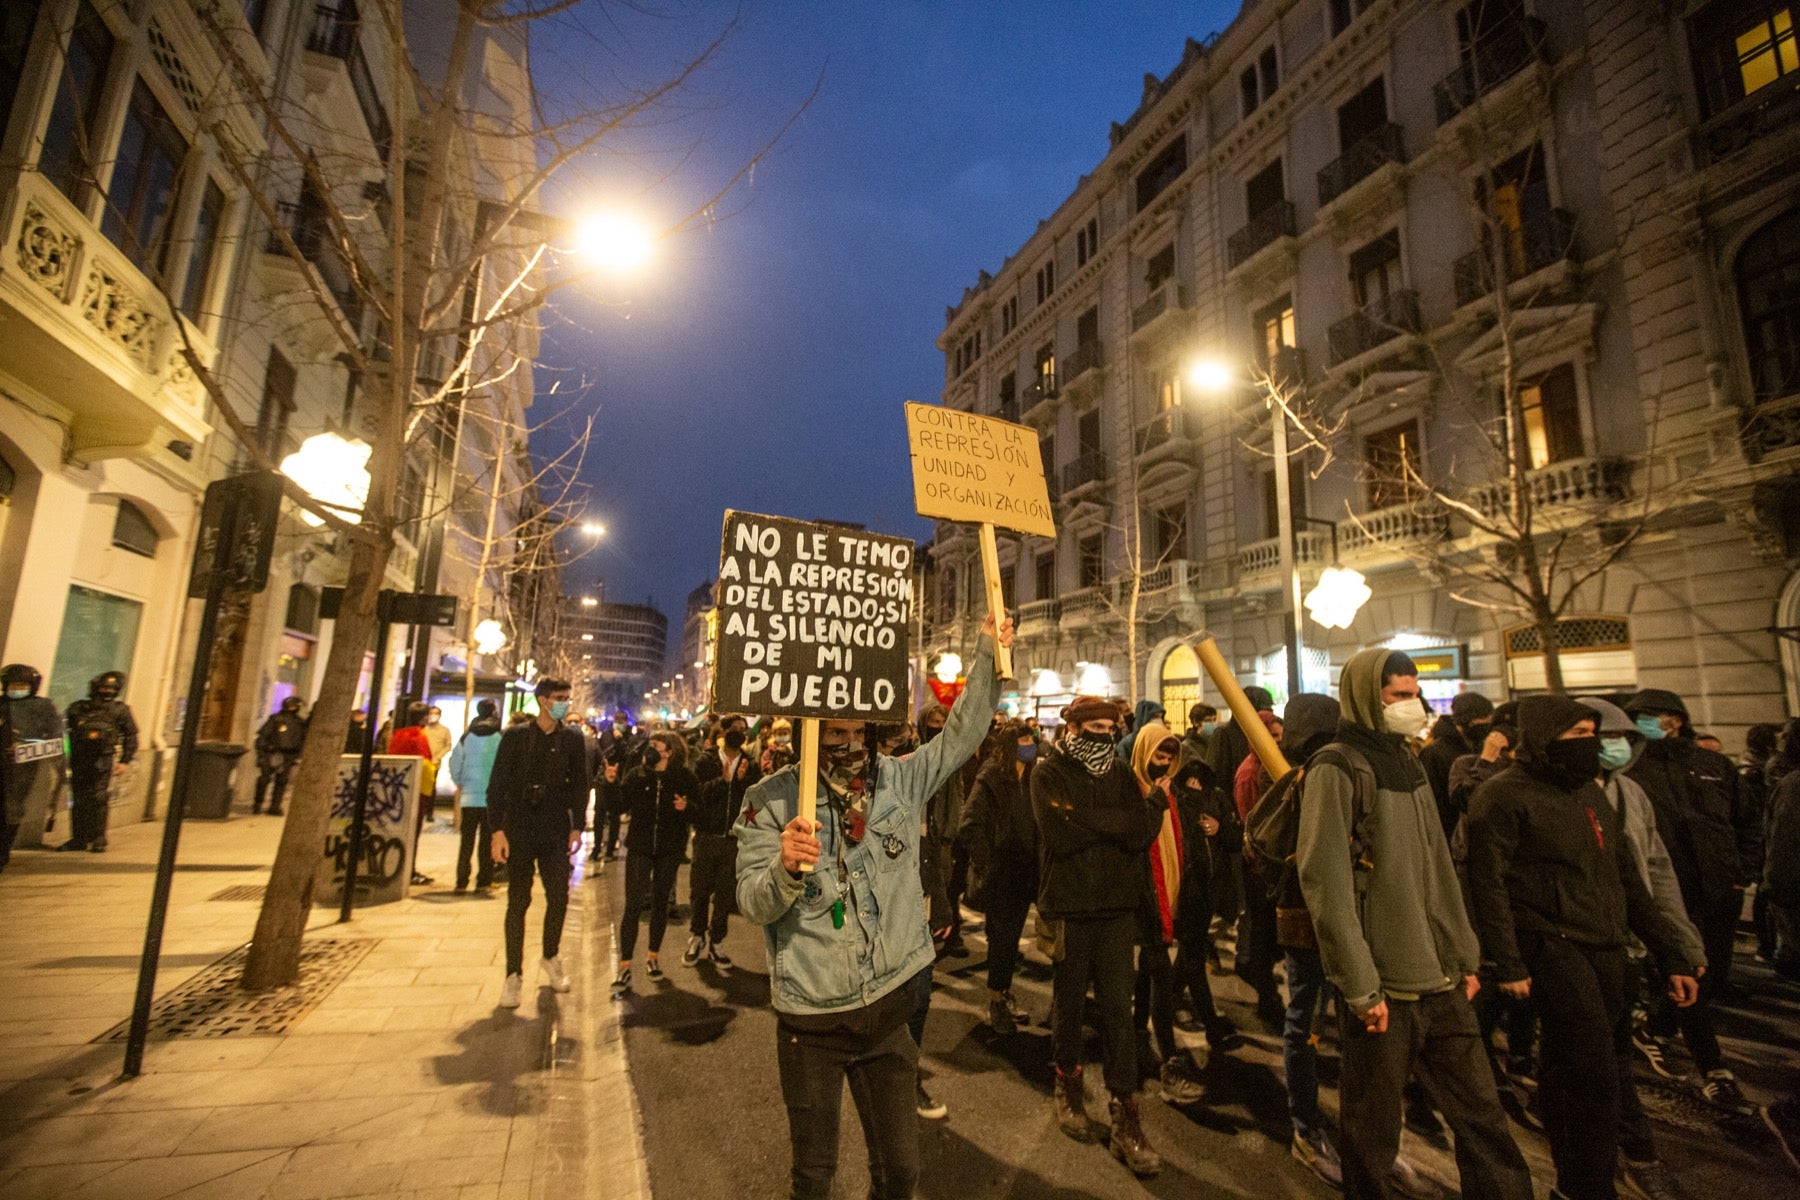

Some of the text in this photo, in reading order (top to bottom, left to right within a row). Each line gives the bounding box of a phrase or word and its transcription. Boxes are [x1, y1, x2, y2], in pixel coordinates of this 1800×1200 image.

[915, 407, 1023, 445] CONTRA LA
[920, 430, 1029, 468] REPRESIÓN
[923, 457, 1015, 487] UNIDAD Y
[926, 482, 1051, 520] ORGANIZACIÓN
[735, 523, 910, 570] NO LE TEMO
[720, 556, 913, 601] A LA REPRESIÓN
[726, 585, 774, 611] DEL
[725, 612, 896, 649] AL SILENCIO
[743, 641, 852, 672] DE MI
[740, 668, 896, 711] PUEBLO
[17, 740, 61, 761] POLICIA
